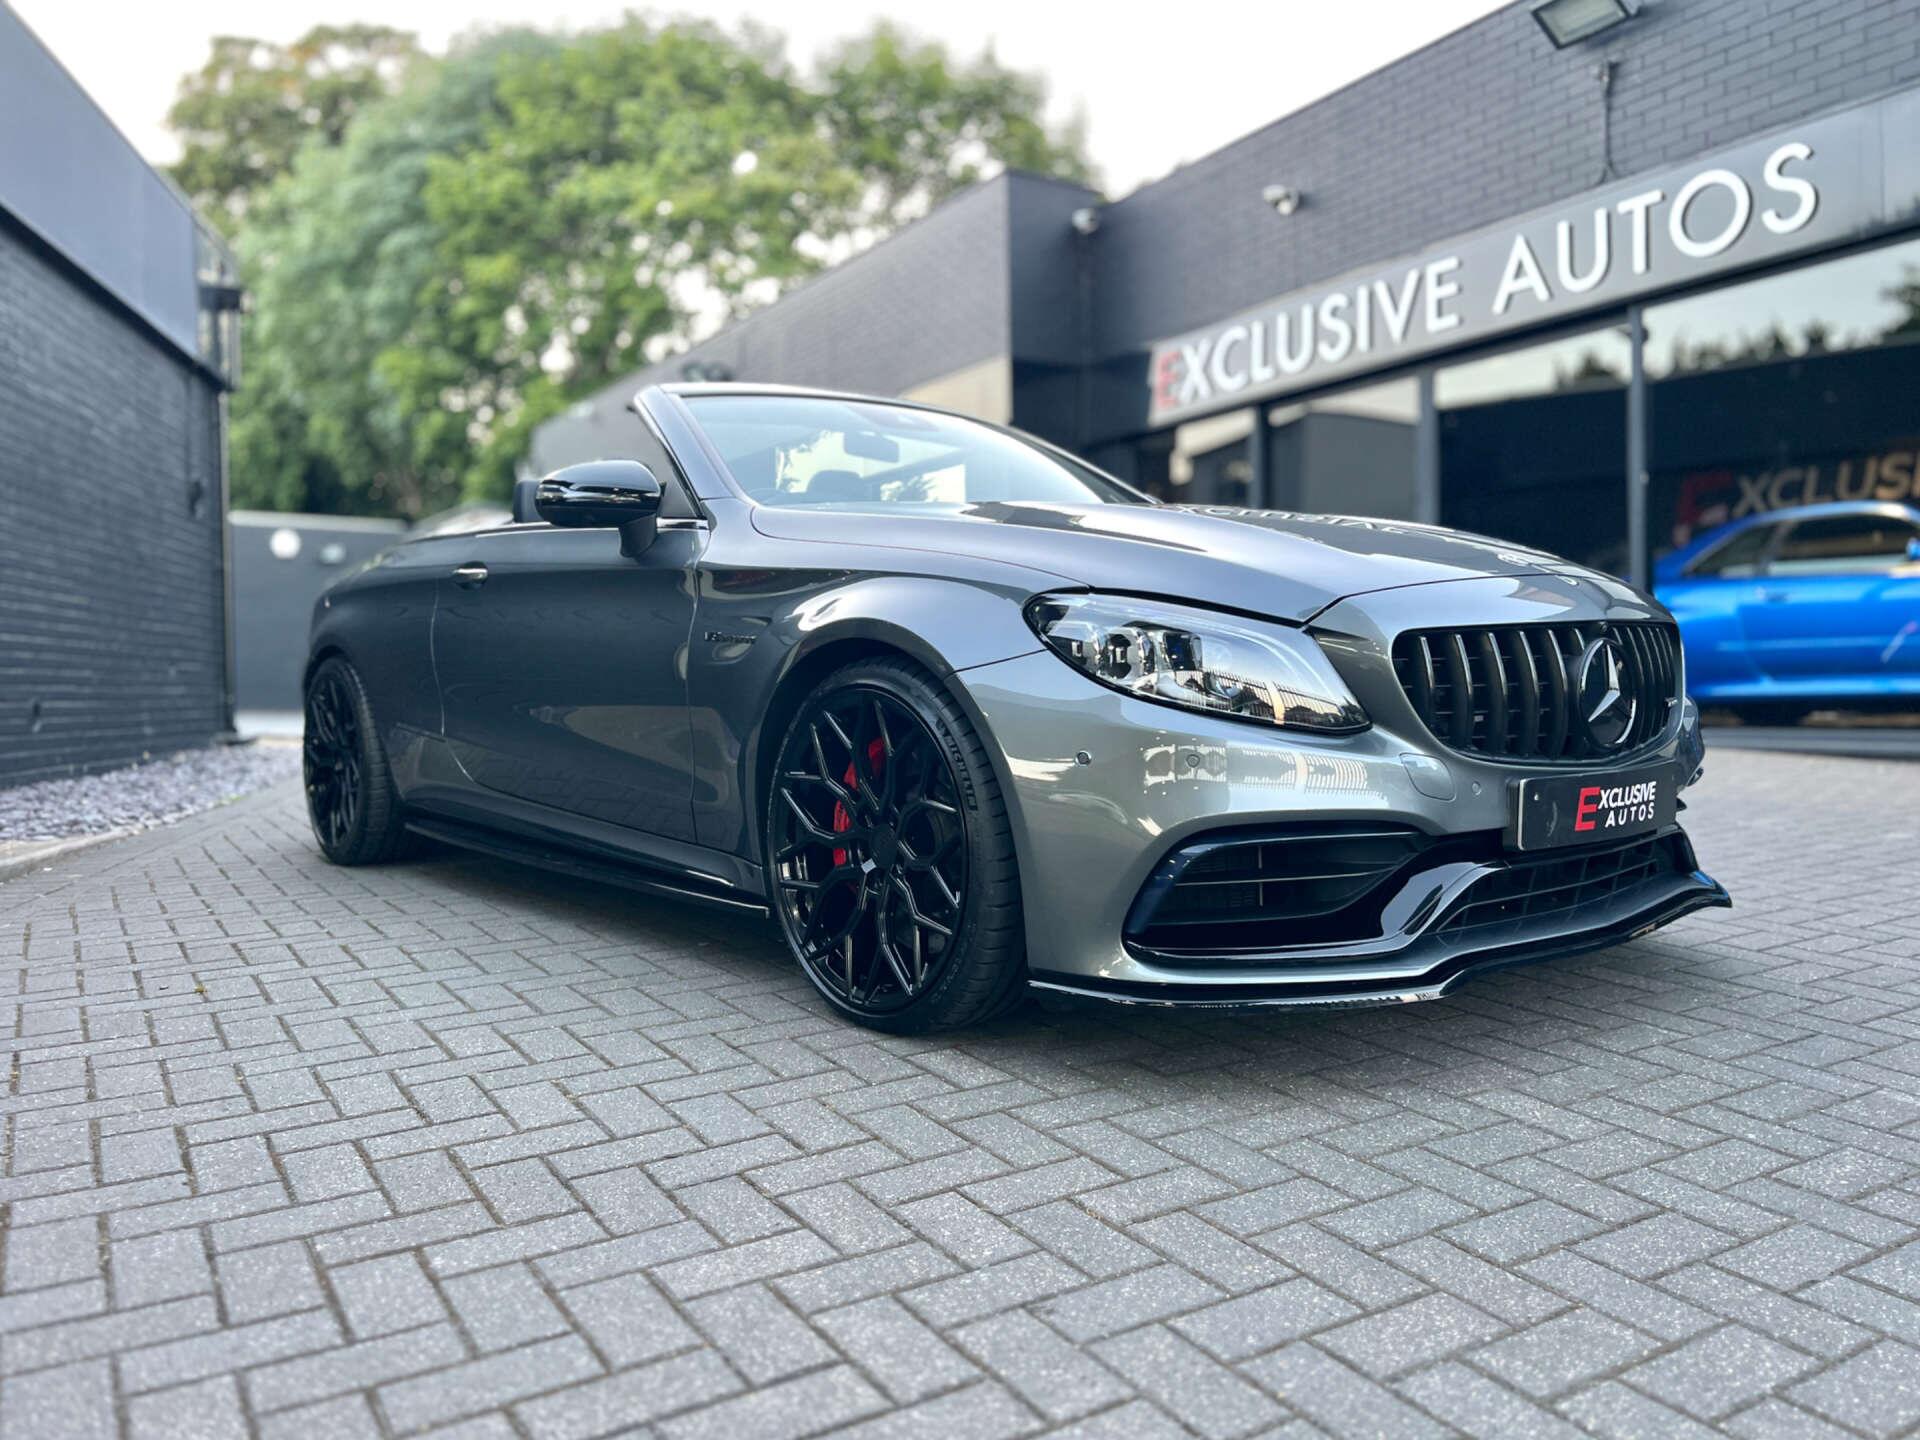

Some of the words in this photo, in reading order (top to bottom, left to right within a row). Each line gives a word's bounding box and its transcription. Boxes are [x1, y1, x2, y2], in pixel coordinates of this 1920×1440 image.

[1154, 256, 1462, 409] EXCLUSIVE
[1492, 142, 1819, 315] AUTOS
[1575, 781, 1656, 831] EXCLUSIVE
[1605, 802, 1655, 828] AUTOS
